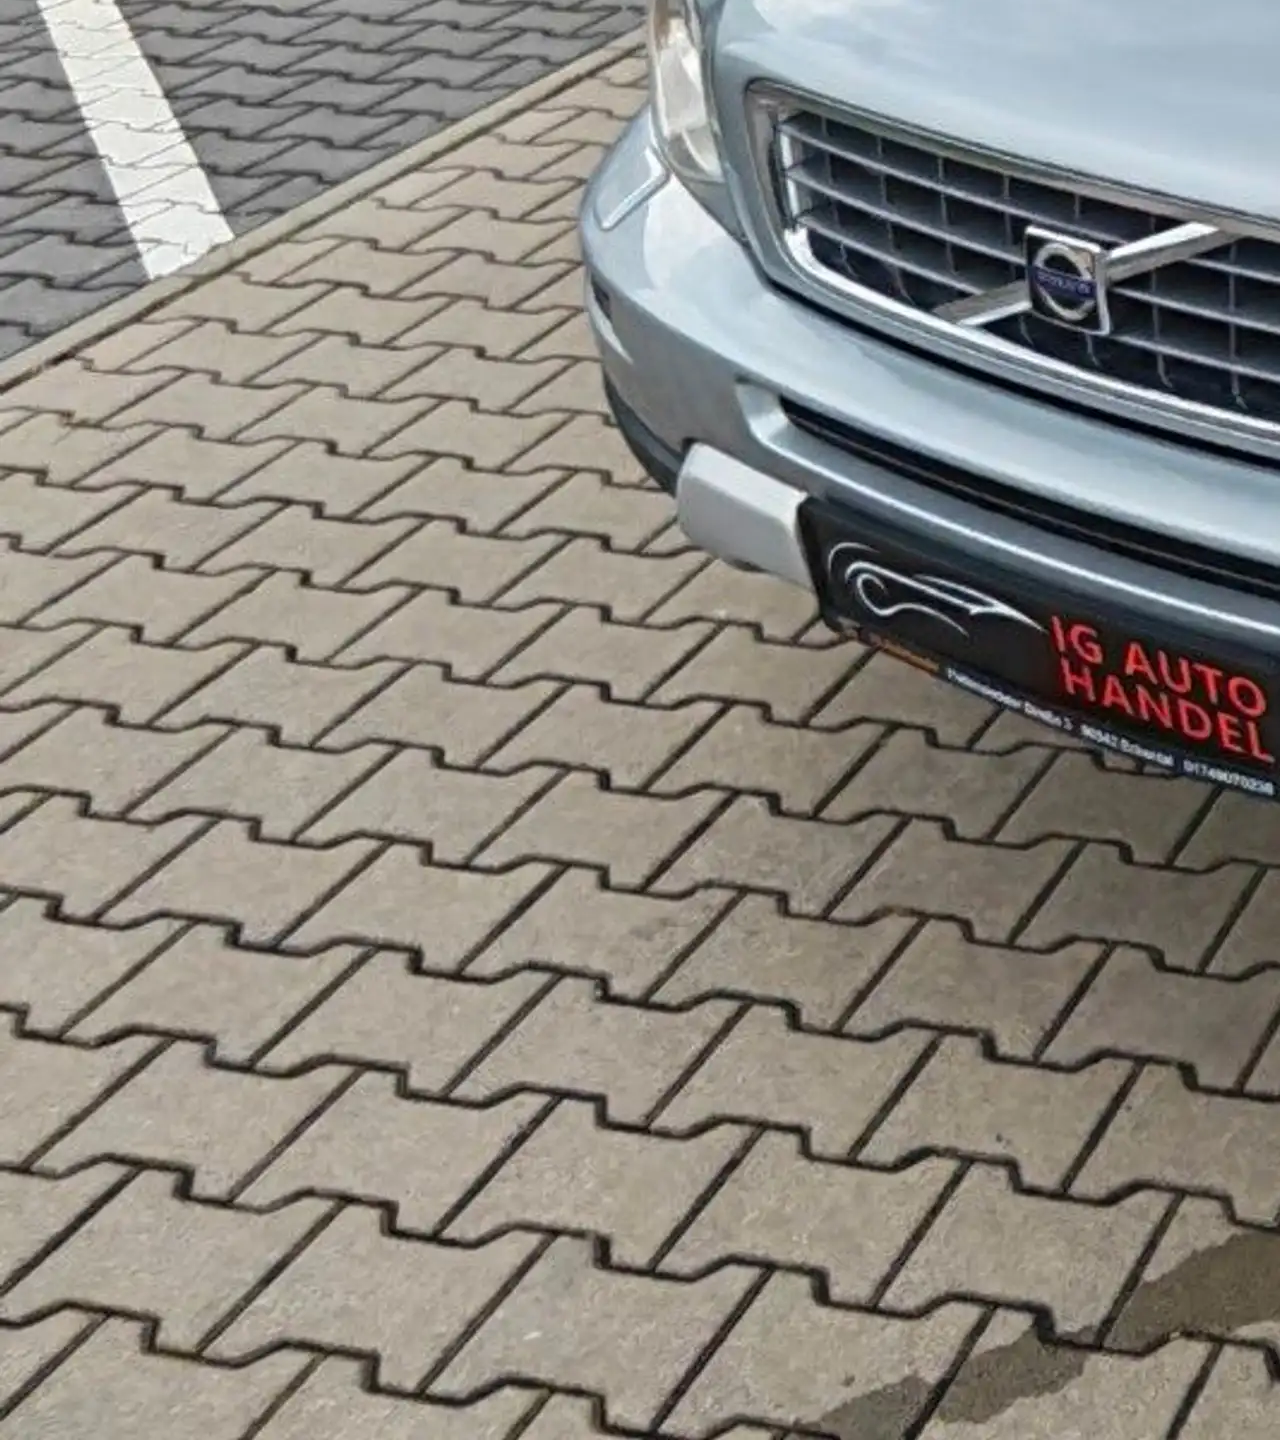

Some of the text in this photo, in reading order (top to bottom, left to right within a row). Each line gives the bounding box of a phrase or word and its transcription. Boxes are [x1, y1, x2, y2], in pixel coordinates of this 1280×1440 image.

[1051, 615, 1267, 718] IG AUTO
[1060, 657, 1276, 764] HANDEL
